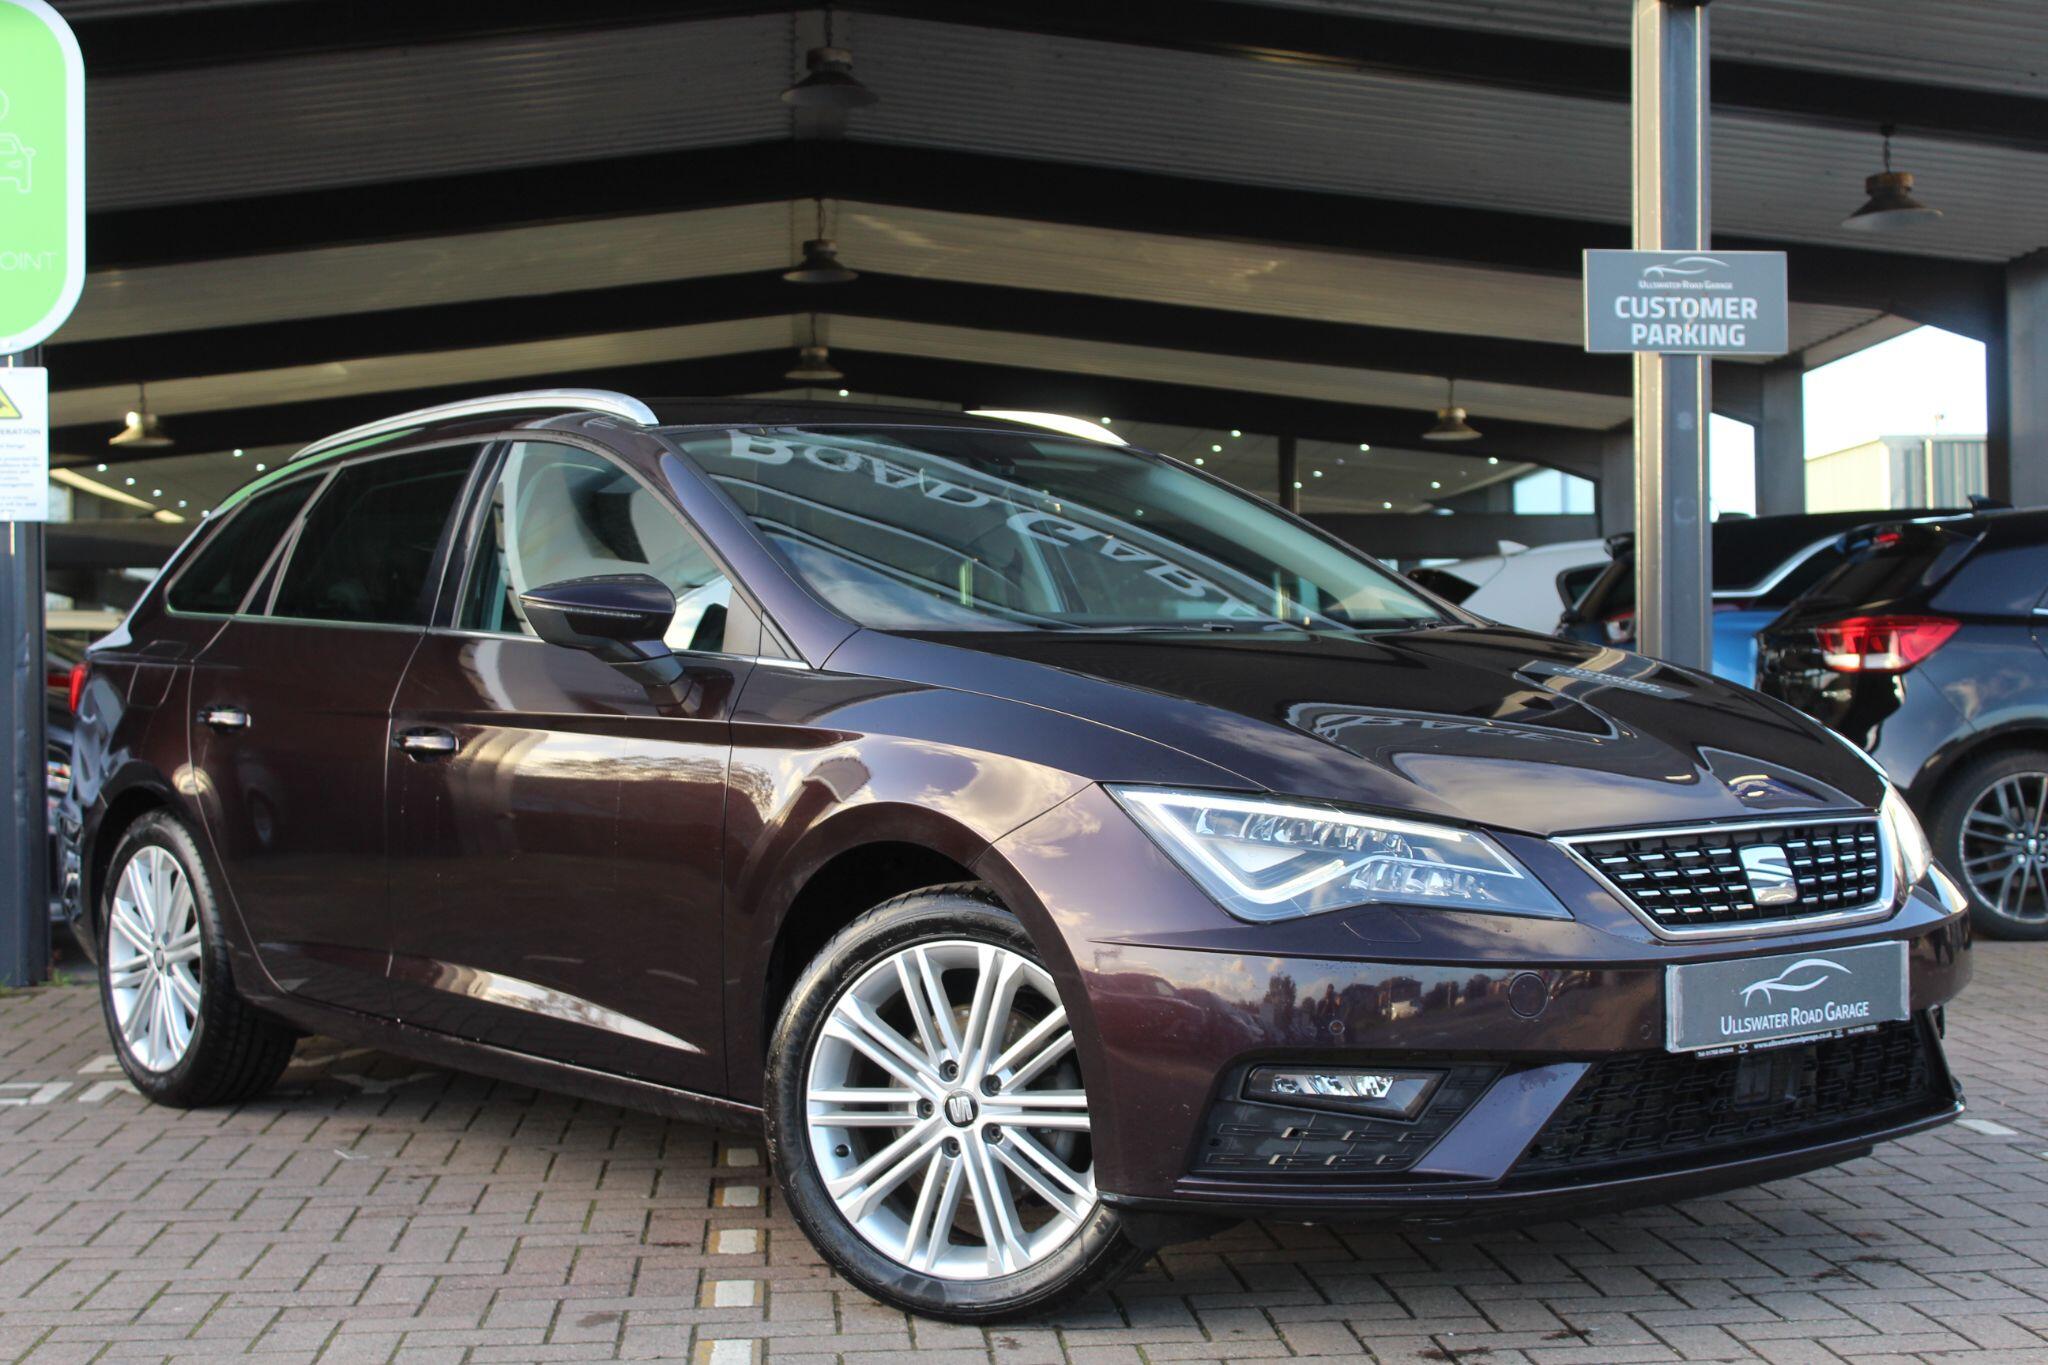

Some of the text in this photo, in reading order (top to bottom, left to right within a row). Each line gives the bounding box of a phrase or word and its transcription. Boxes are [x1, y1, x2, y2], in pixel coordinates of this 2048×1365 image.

[1614, 296, 1758, 320] CUSTOMER
[1631, 323, 1746, 346] PARKING
[1720, 1001, 1870, 1035] ULLSWATER ROAD GARAGE
